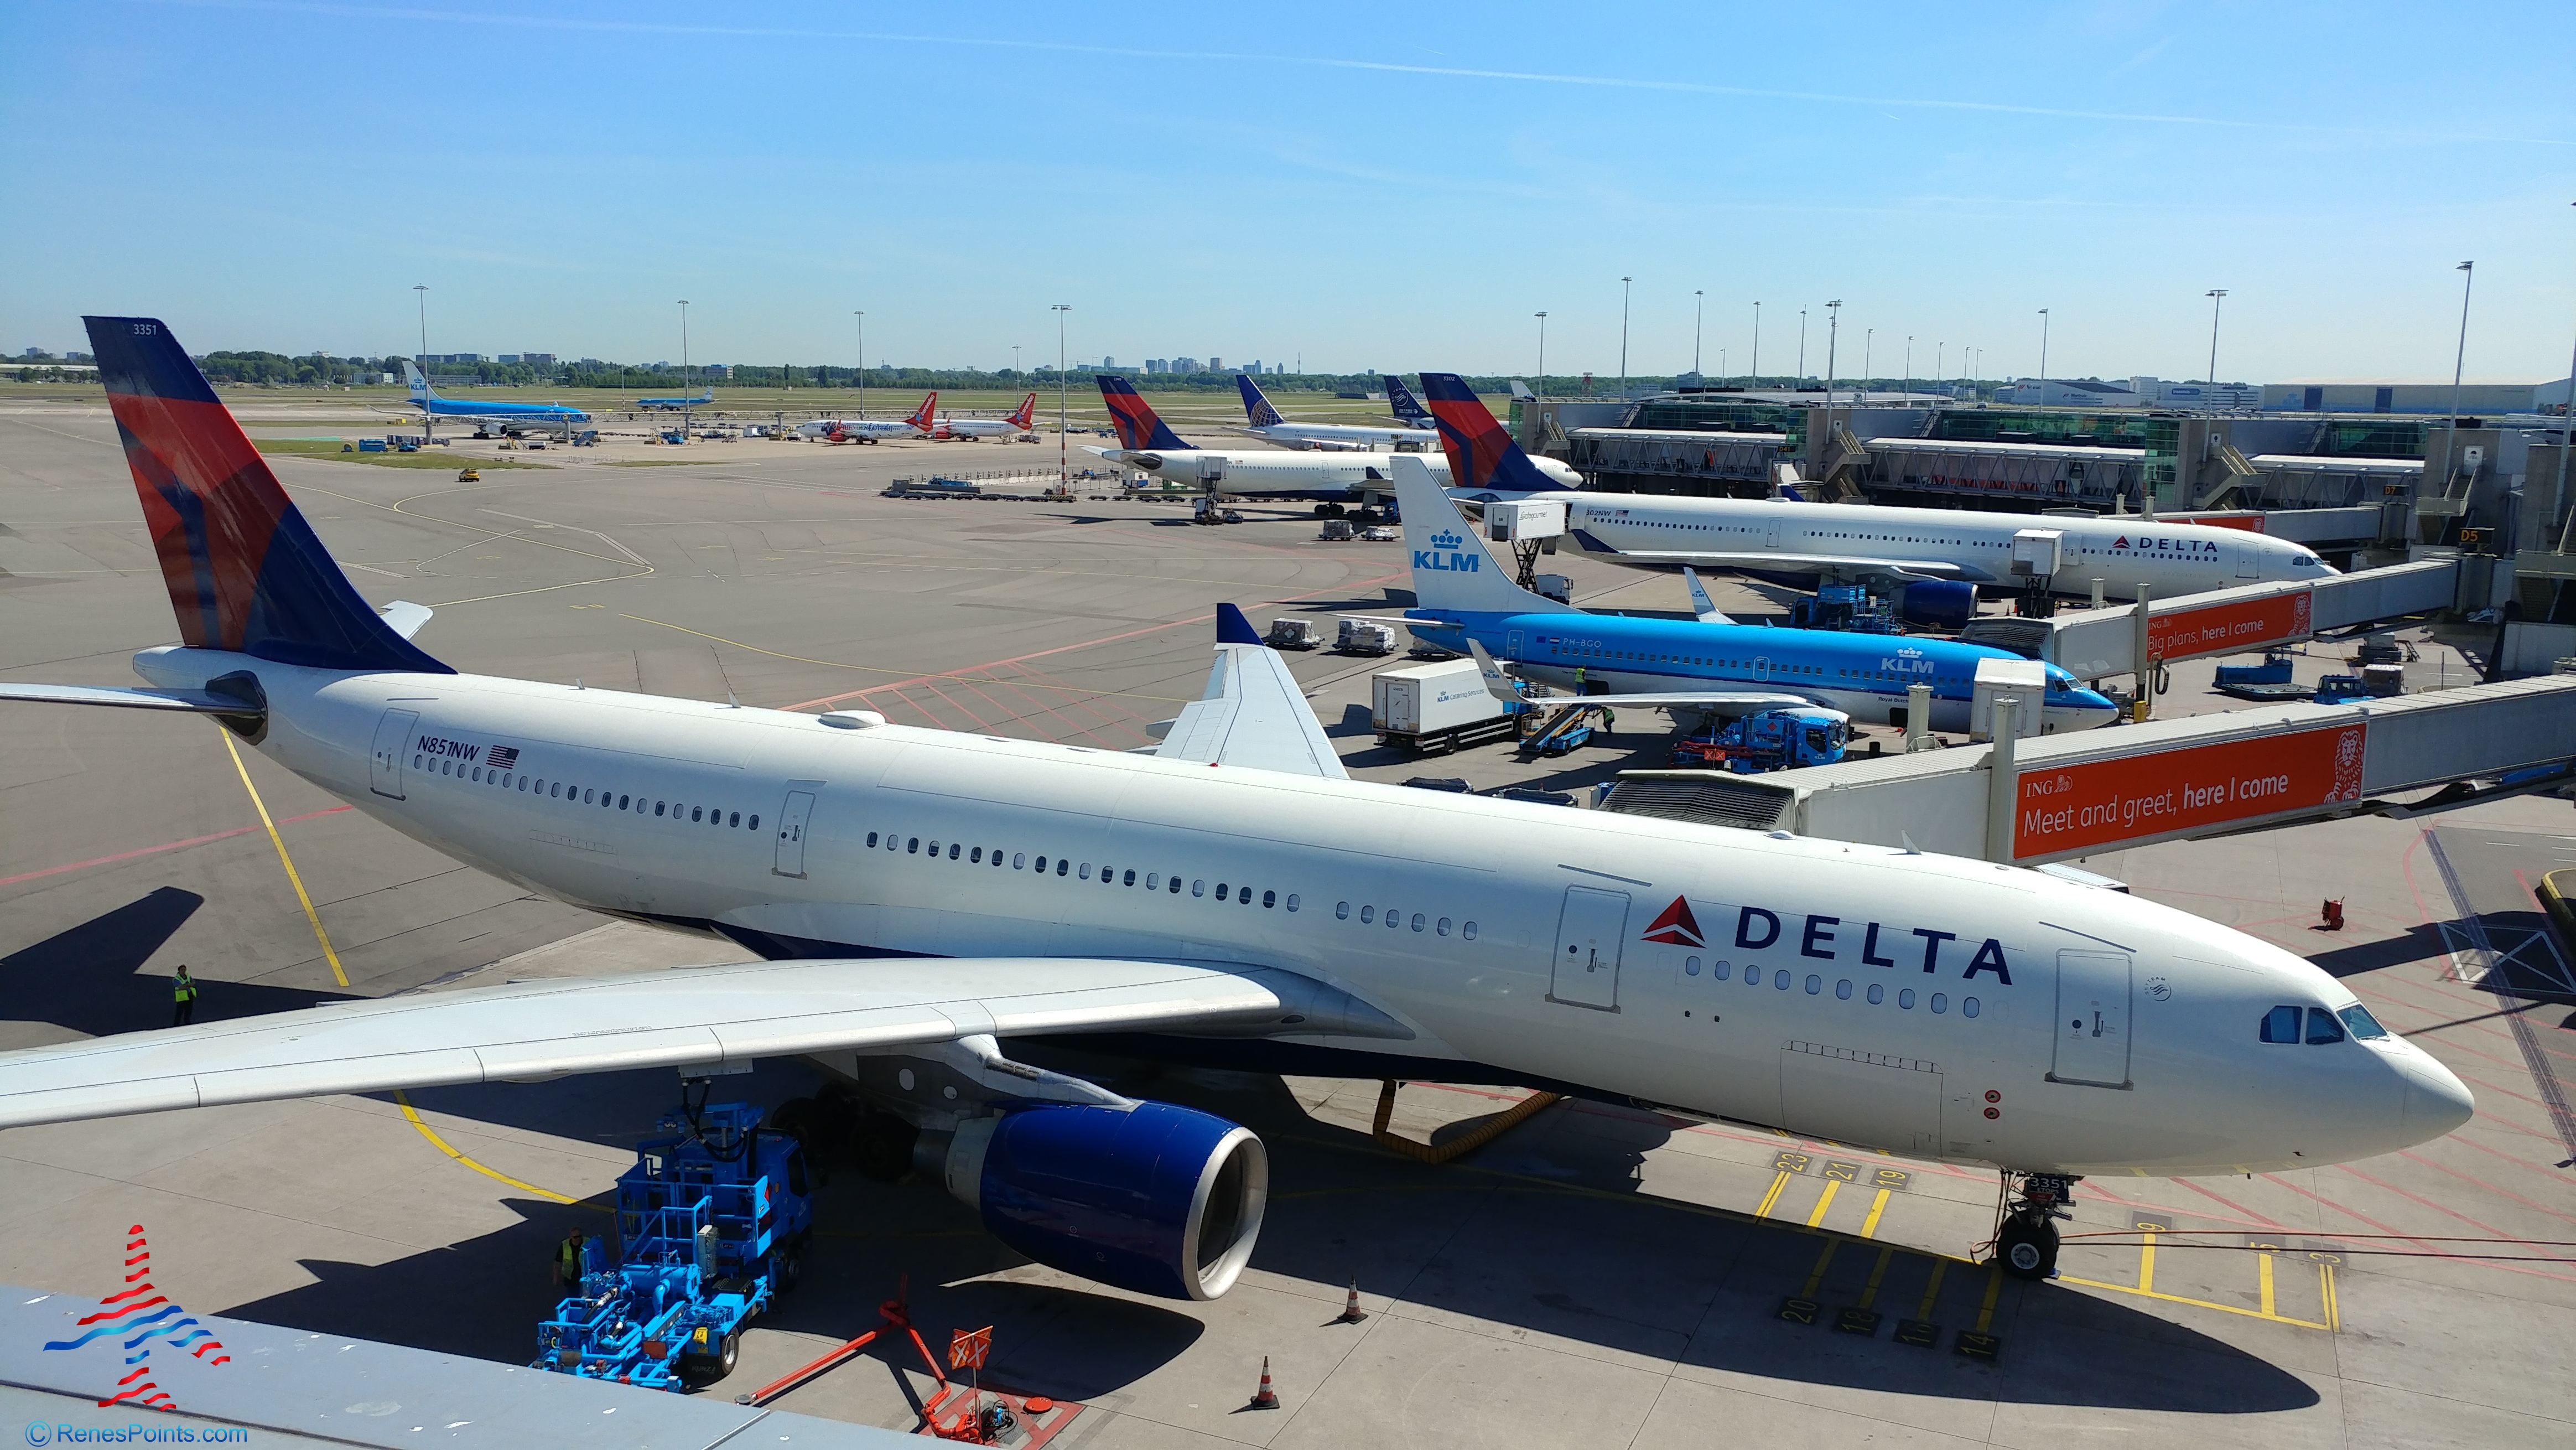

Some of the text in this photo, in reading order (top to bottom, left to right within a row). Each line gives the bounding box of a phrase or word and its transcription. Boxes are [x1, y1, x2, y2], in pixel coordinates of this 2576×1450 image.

[133, 324, 157, 335] 3351
[921, 395, 935, 416] corendon
[1021, 395, 1034, 415] corendon
[2385, 486, 2396, 495] D7
[2139, 537, 2217, 552] DELTA
[2461, 530, 2478, 542] D5
[1414, 551, 1479, 572] KLM
[2148, 620, 2162, 630] ING
[1563, 638, 1602, 648] PH-BGO
[2148, 619, 2264, 652] Big plans, here I come
[1881, 657, 1934, 674] KLM
[417, 735, 481, 761] N851NW
[2026, 780, 2053, 798] ING
[2024, 774, 2288, 837] Meet and greet, here I come
[1735, 906, 2012, 986] DELTA
[2144, 976, 2165, 995] SKYTEAM
[1826, 1162, 1856, 1180] 21
[1876, 1170, 1905, 1186] 19
[2030, 1177, 2068, 1189] 3351
[1781, 1299, 1817, 1324] 20
[1842, 1311, 1875, 1331] 18
[1960, 1334, 1995, 1355] 14
